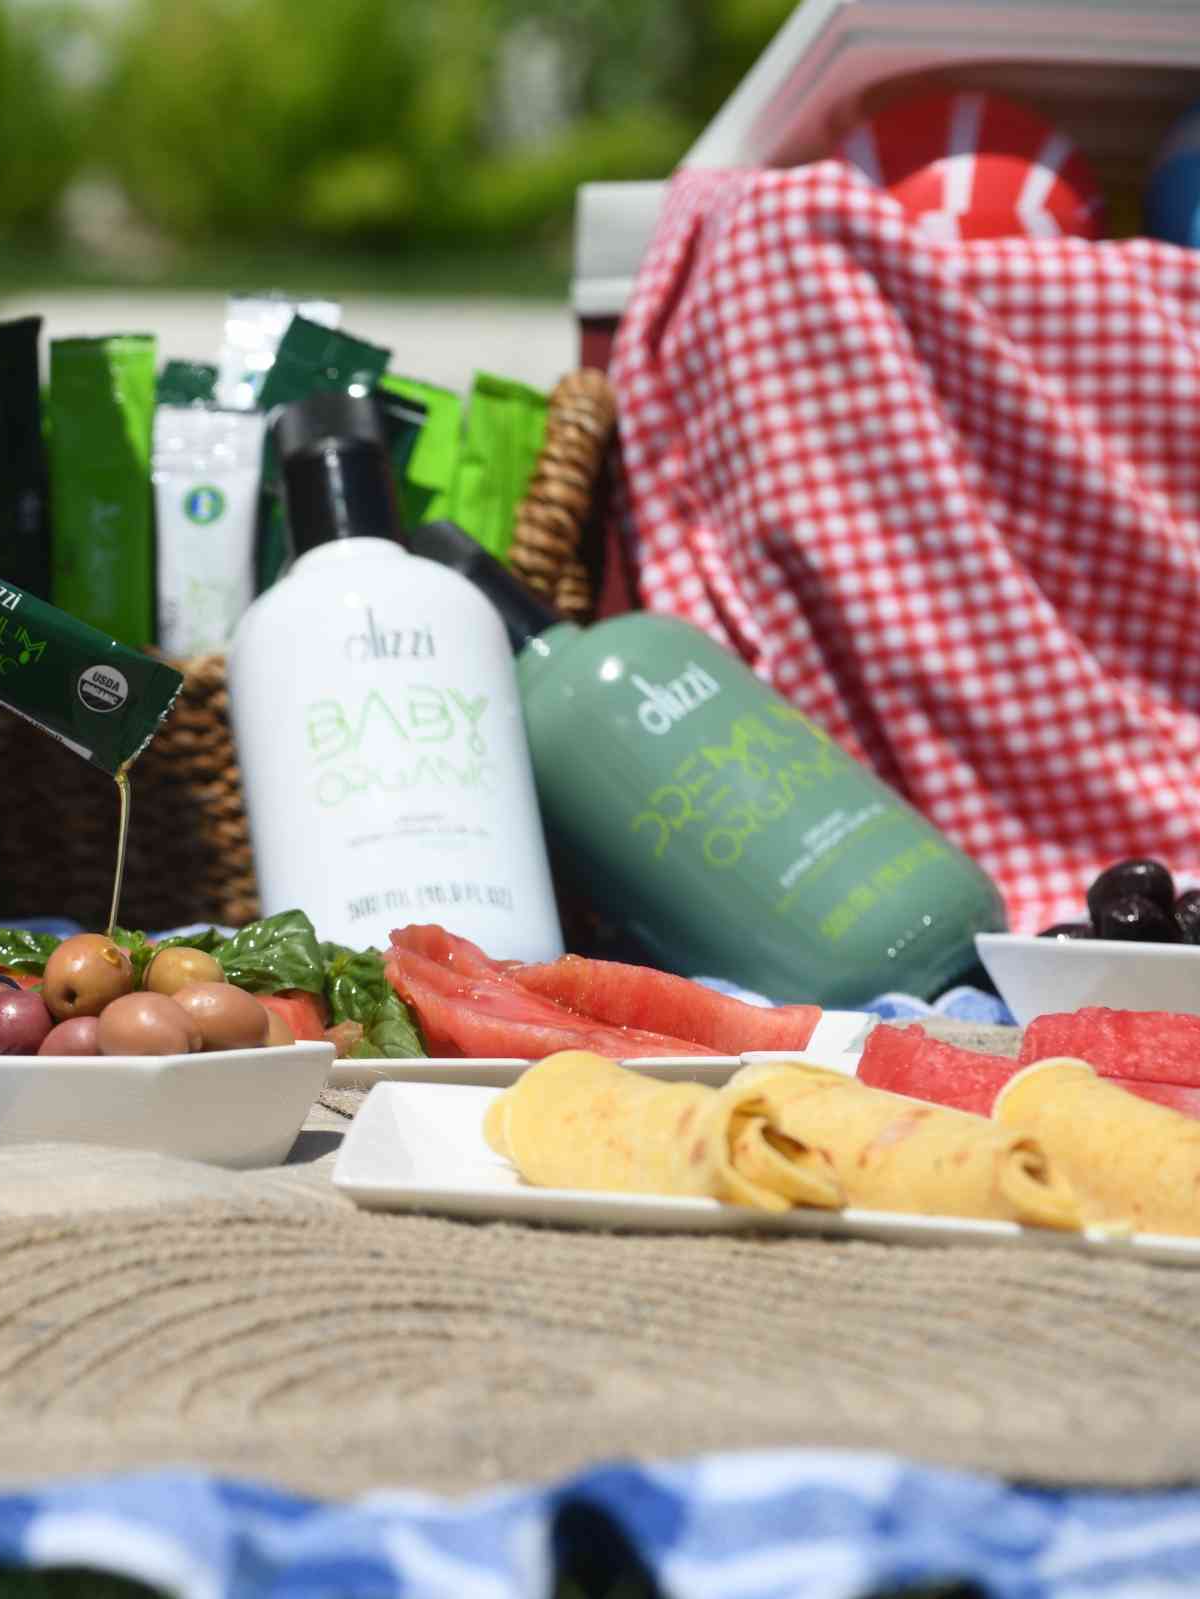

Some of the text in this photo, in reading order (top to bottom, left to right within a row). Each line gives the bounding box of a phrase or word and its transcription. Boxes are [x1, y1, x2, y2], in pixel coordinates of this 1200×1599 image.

[344, 605, 437, 660] olizzi
[91, 670, 121, 694] USDA
[630, 661, 721, 736] olizzi
[306, 685, 491, 763] BABY
